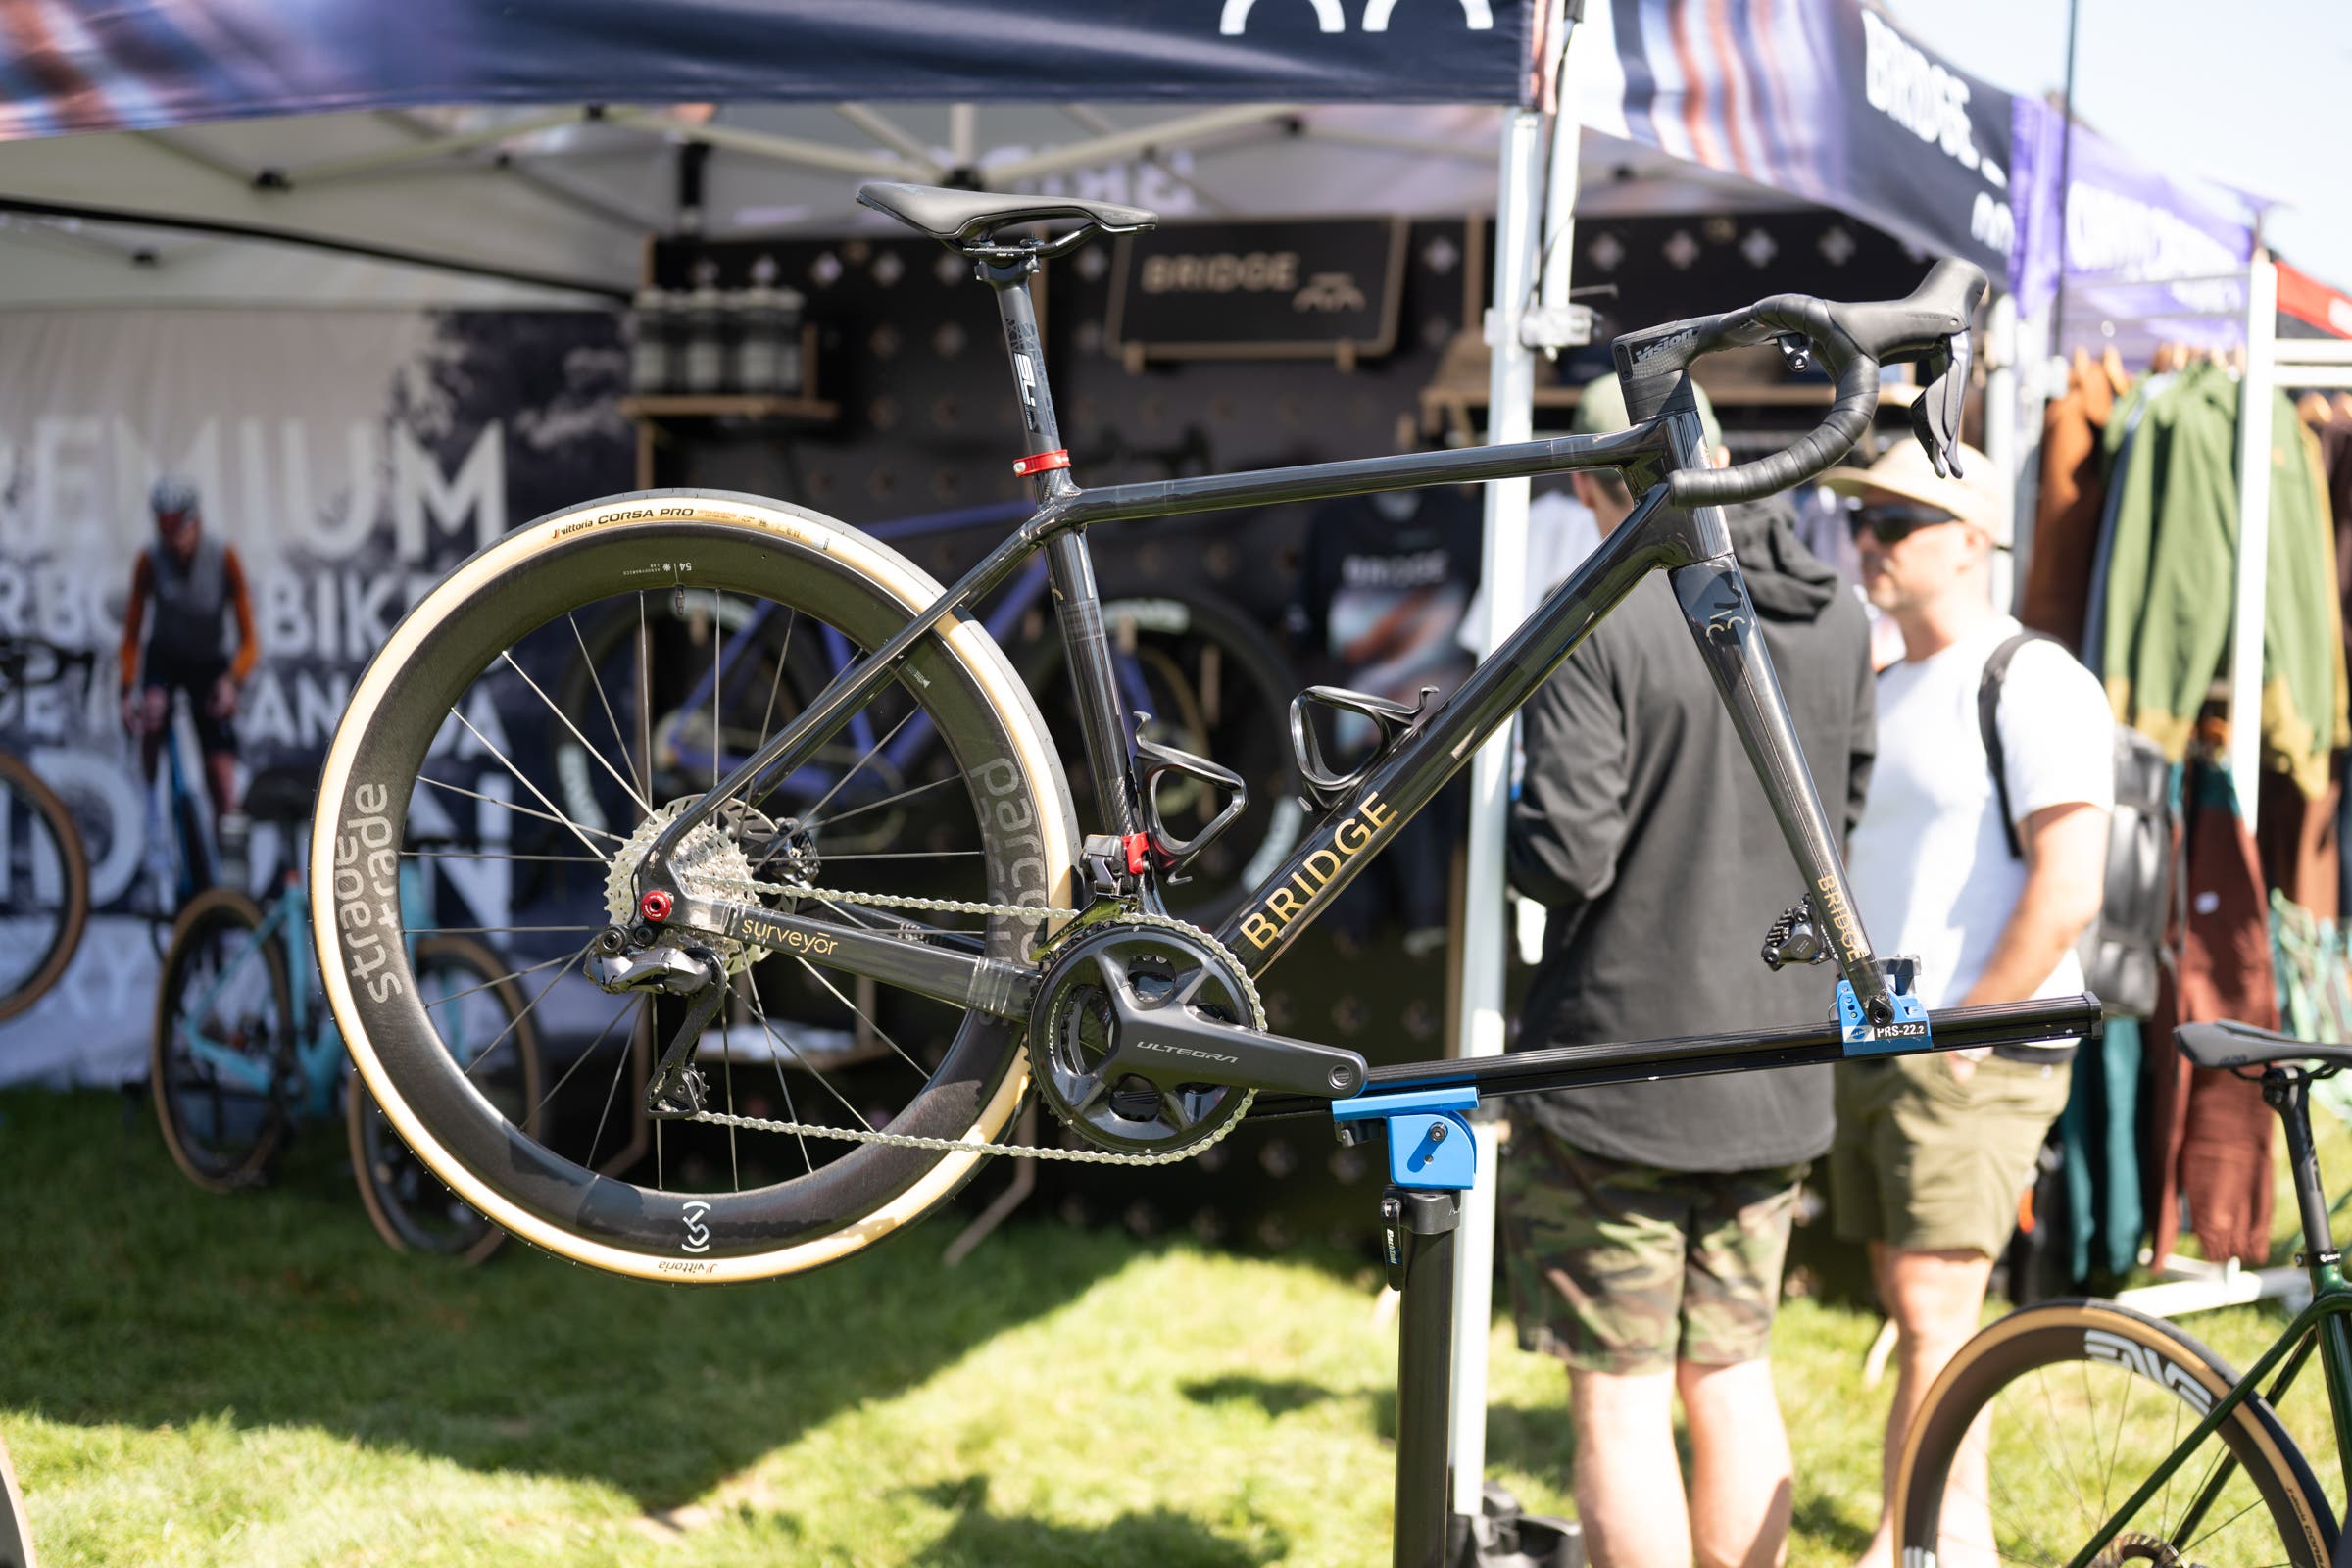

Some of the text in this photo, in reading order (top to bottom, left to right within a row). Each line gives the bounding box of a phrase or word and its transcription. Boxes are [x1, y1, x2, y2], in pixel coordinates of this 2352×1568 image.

[1142, 252, 1300, 293] BRIDGE
[0, 416, 509, 562] EMIUM
[560, 519, 593, 535] vittoria
[598, 509, 654, 525] CORSA
[660, 508, 694, 516] PRO
[679, 563, 692, 571] 54
[347, 783, 403, 947] trade
[1240, 791, 1398, 950] BRIDGE
[1818, 875, 1871, 963] BRIDGE
[1049, 1001, 1059, 1054] ULTEGRA
[1876, 1025, 1925, 1038] PRS-22.2
[1137, 1041, 1239, 1063] ULTEGRA
[659, 1261, 705, 1274] vittoria
